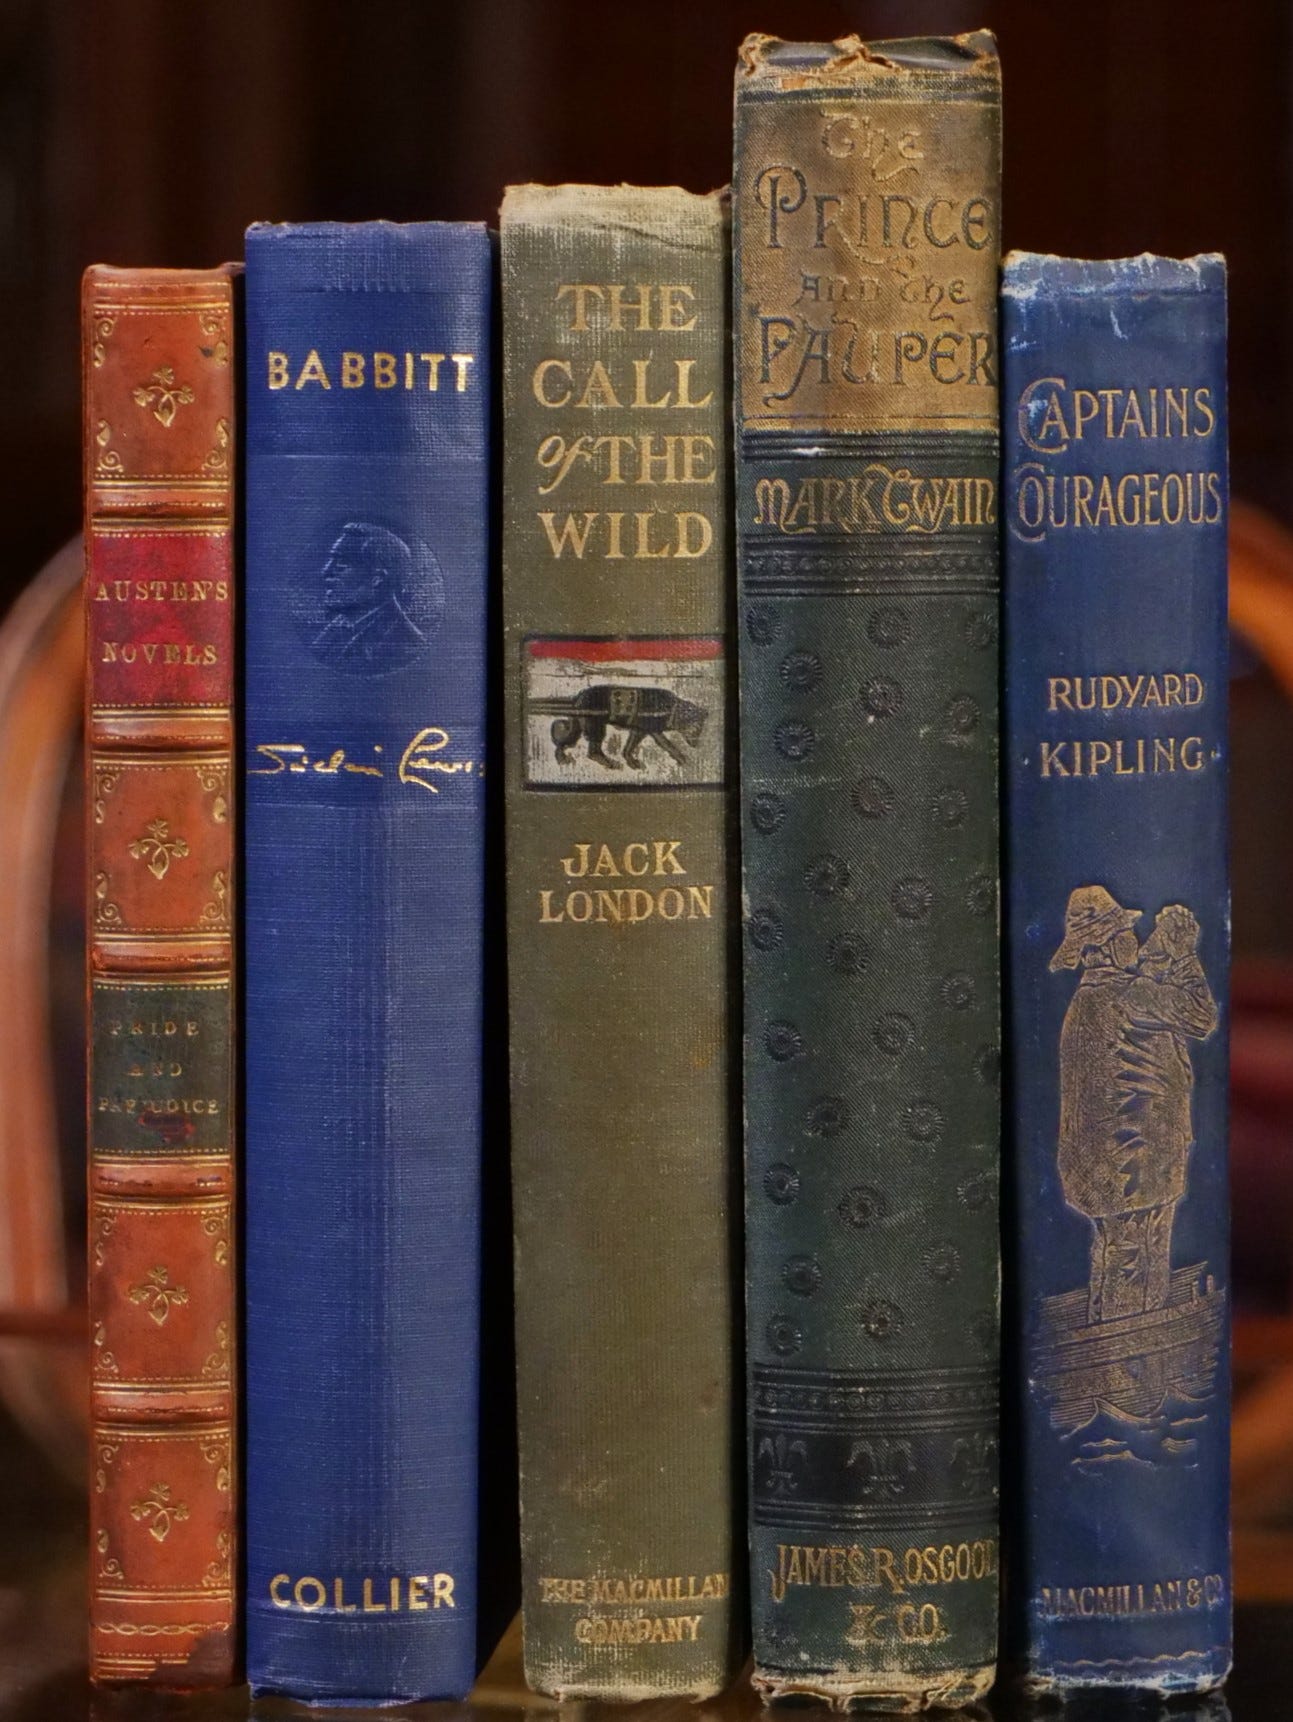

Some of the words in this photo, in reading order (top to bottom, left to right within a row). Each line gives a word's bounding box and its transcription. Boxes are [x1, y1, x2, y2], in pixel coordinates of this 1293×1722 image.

[554, 284, 697, 331] THE
[267, 350, 474, 391] BABBITT
[532, 359, 714, 408] CALL
[1018, 377, 1215, 453] CAPTAINS
[537, 435, 594, 495] of
[593, 435, 717, 484] THE
[863, 463, 996, 534] TWAIN
[1009, 462, 1223, 542] COURAGEOUS
[537, 511, 713, 559] WILD
[101, 642, 218, 665] NOVELS
[1048, 673, 1204, 711] RUDYARD
[560, 841, 687, 877] JACK
[538, 886, 714, 923] LONDON
[269, 1573, 455, 1611] COLLIER
[589, 1573, 731, 1604] MACMILLAN
[767, 1544, 866, 1603] JAMES
[574, 1615, 703, 1644] COMPANY
